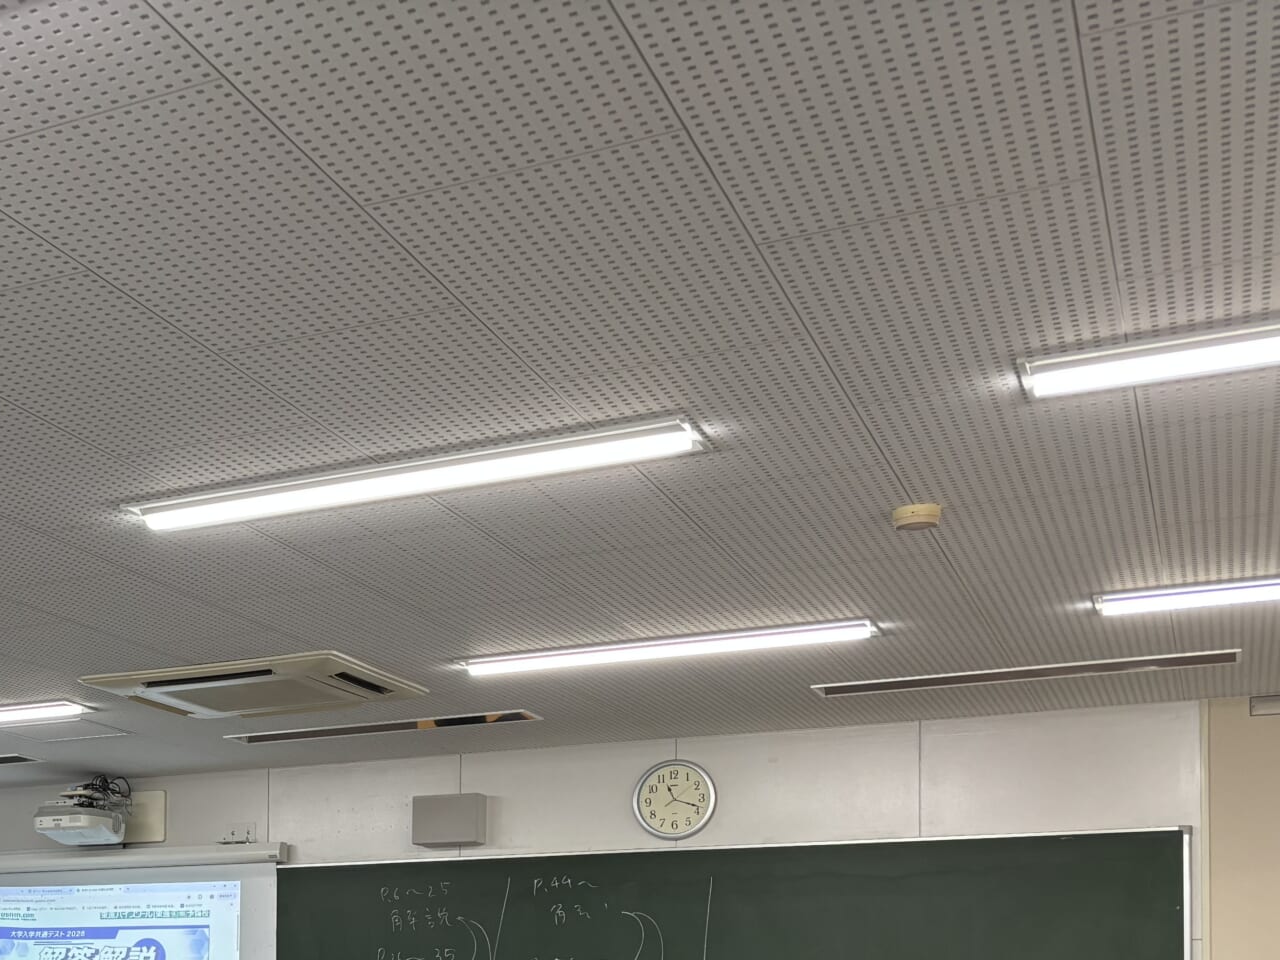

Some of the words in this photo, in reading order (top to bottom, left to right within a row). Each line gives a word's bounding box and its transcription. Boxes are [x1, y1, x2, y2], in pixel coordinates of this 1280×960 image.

[657, 774, 665, 784] 11
[669, 769, 679, 780] 12
[685, 772, 690, 782] 1
[648, 784, 658, 794] 10
[693, 780, 701, 791] 2
[644, 797, 652, 807] 9
[698, 793, 705, 802] 3
[649, 810, 656, 819] 8
[694, 805, 700, 815] 4
[659, 818, 666, 828] 7
[671, 820, 678, 830] 6
[685, 817, 691, 826] 5
[10, 930, 65, 938] 大学入学共通テスト
